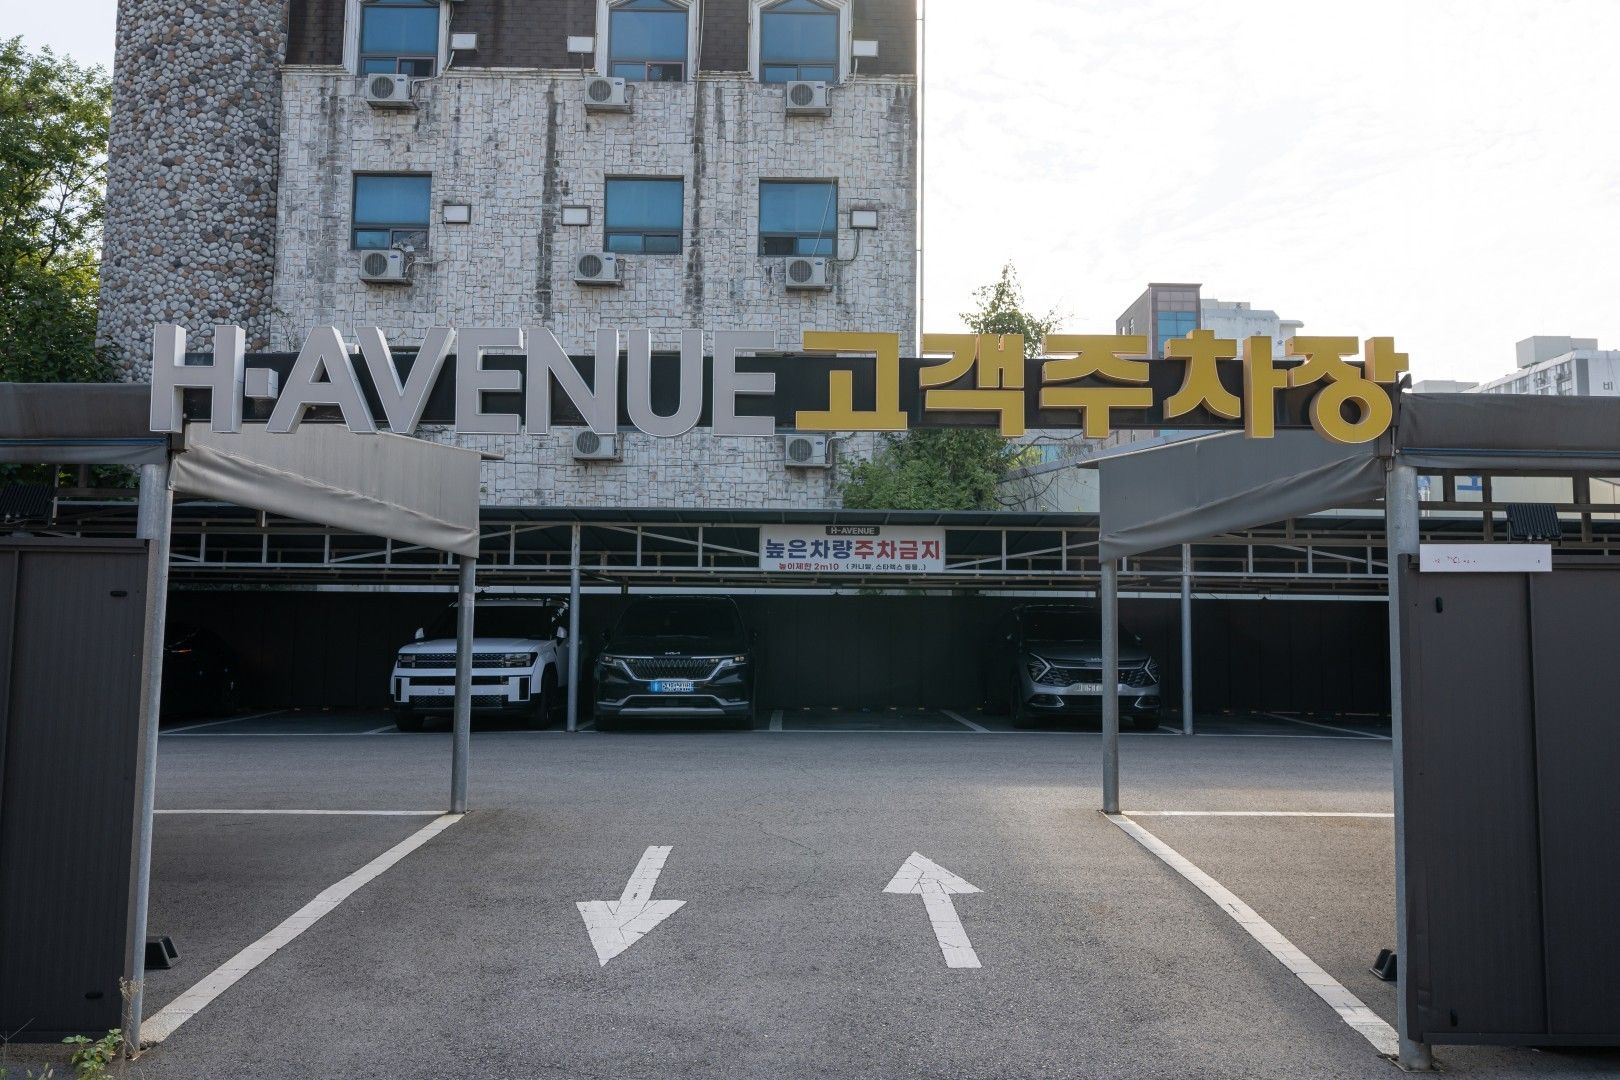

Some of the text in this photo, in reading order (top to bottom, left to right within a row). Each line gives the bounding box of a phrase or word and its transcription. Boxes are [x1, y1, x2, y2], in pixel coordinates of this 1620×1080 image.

[830, 526, 875, 535] H-AVENUE
[778, 562, 812, 571] 높이제한
[814, 562, 839, 571] 2m10
